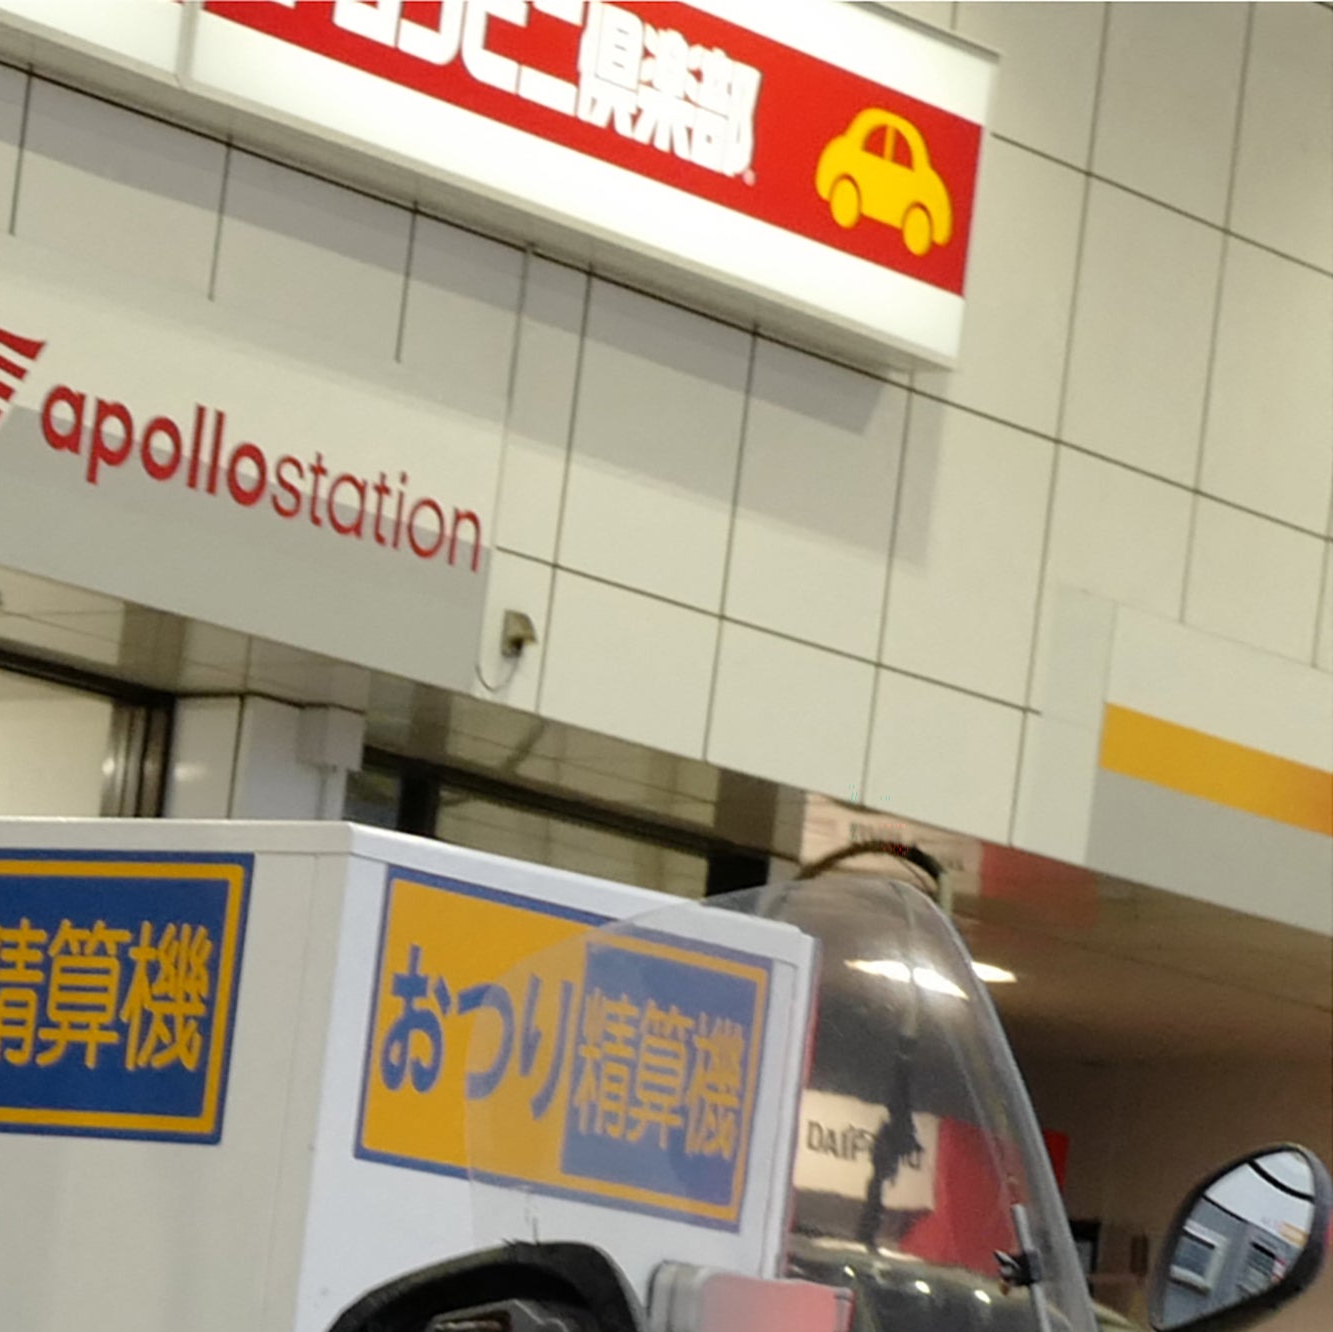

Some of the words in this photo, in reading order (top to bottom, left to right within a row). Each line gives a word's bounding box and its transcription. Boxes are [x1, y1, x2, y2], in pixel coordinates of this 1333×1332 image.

[41, 385, 483, 574] apollostation
[379, 944, 747, 1159] おつり精算機
